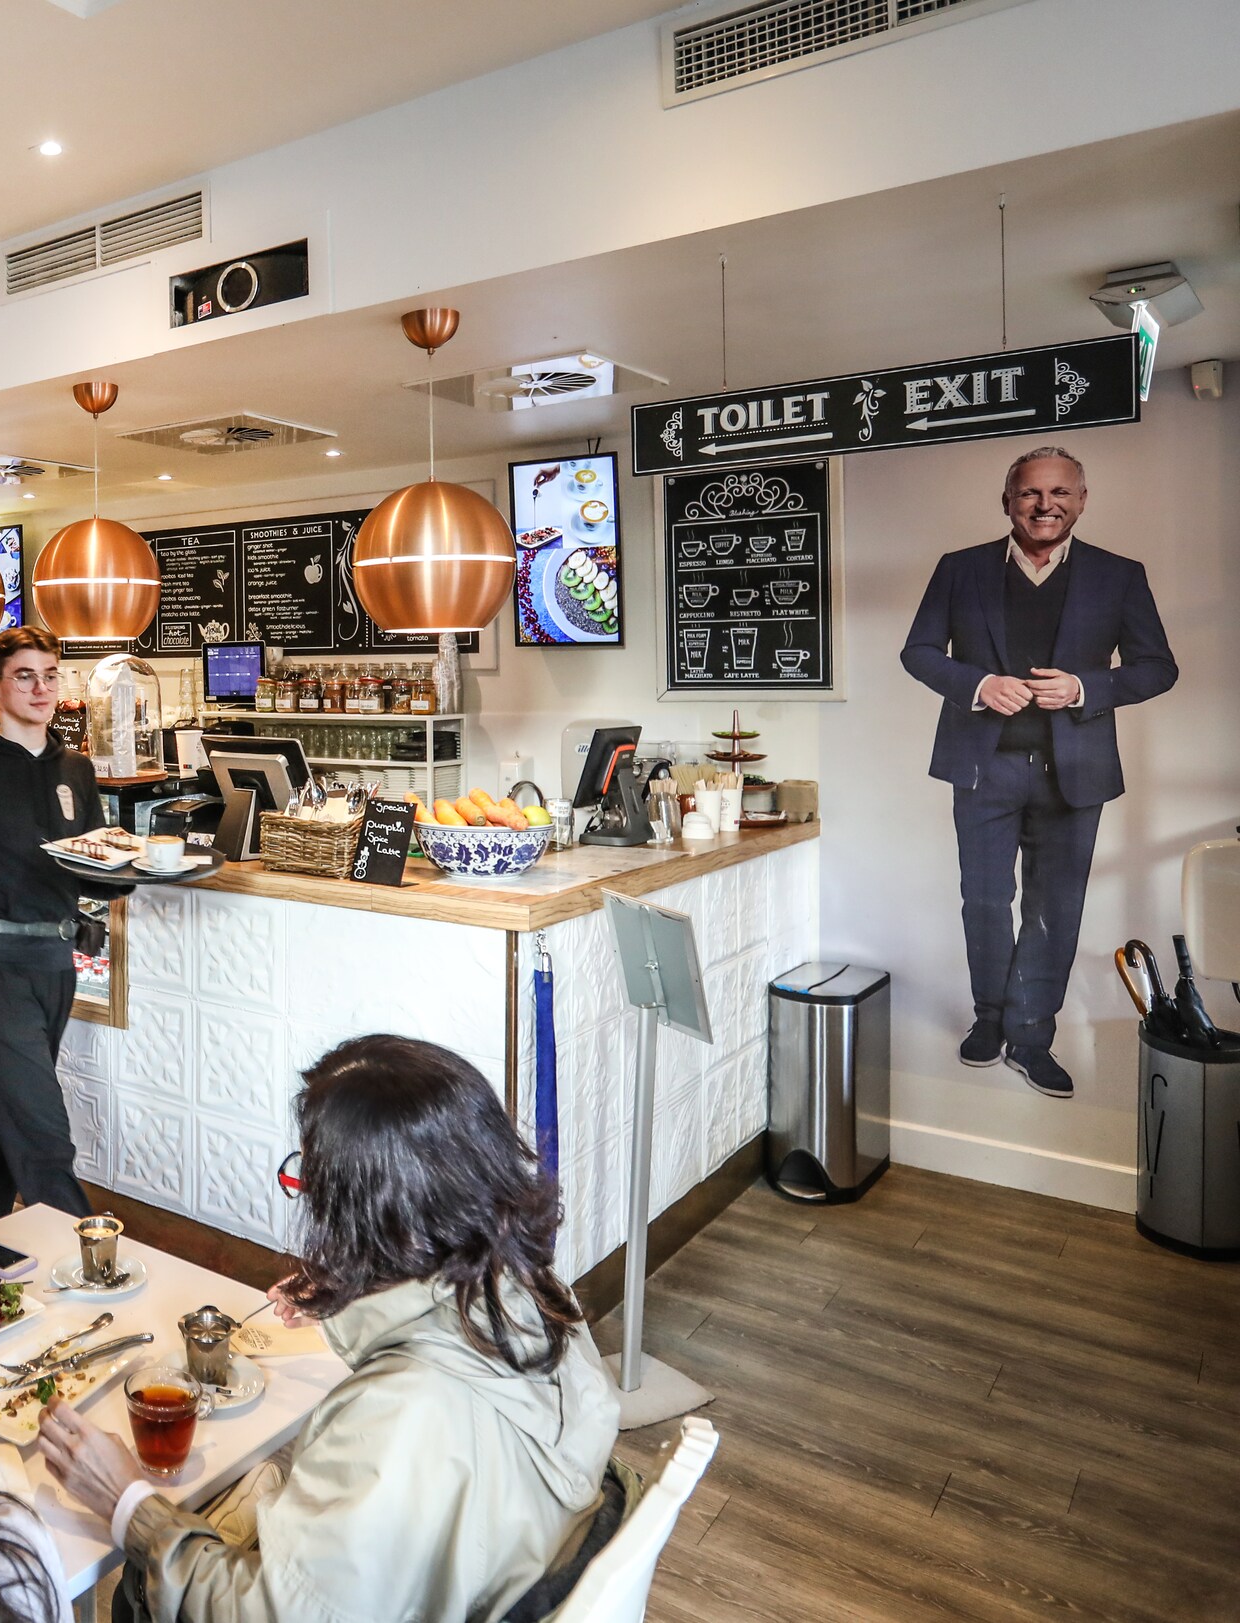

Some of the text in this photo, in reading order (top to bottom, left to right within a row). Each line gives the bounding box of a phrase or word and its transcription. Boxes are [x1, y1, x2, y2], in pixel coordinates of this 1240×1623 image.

[903, 366, 1025, 415] EXIT
[697, 391, 830, 435] TOILET
[250, 525, 322, 539] SMOOTHIES & JUICE
[181, 537, 200, 546] TEA
[163, 636, 189, 645] chocolate
[366, 831, 389, 845] Spice
[376, 843, 401, 858] Latte
